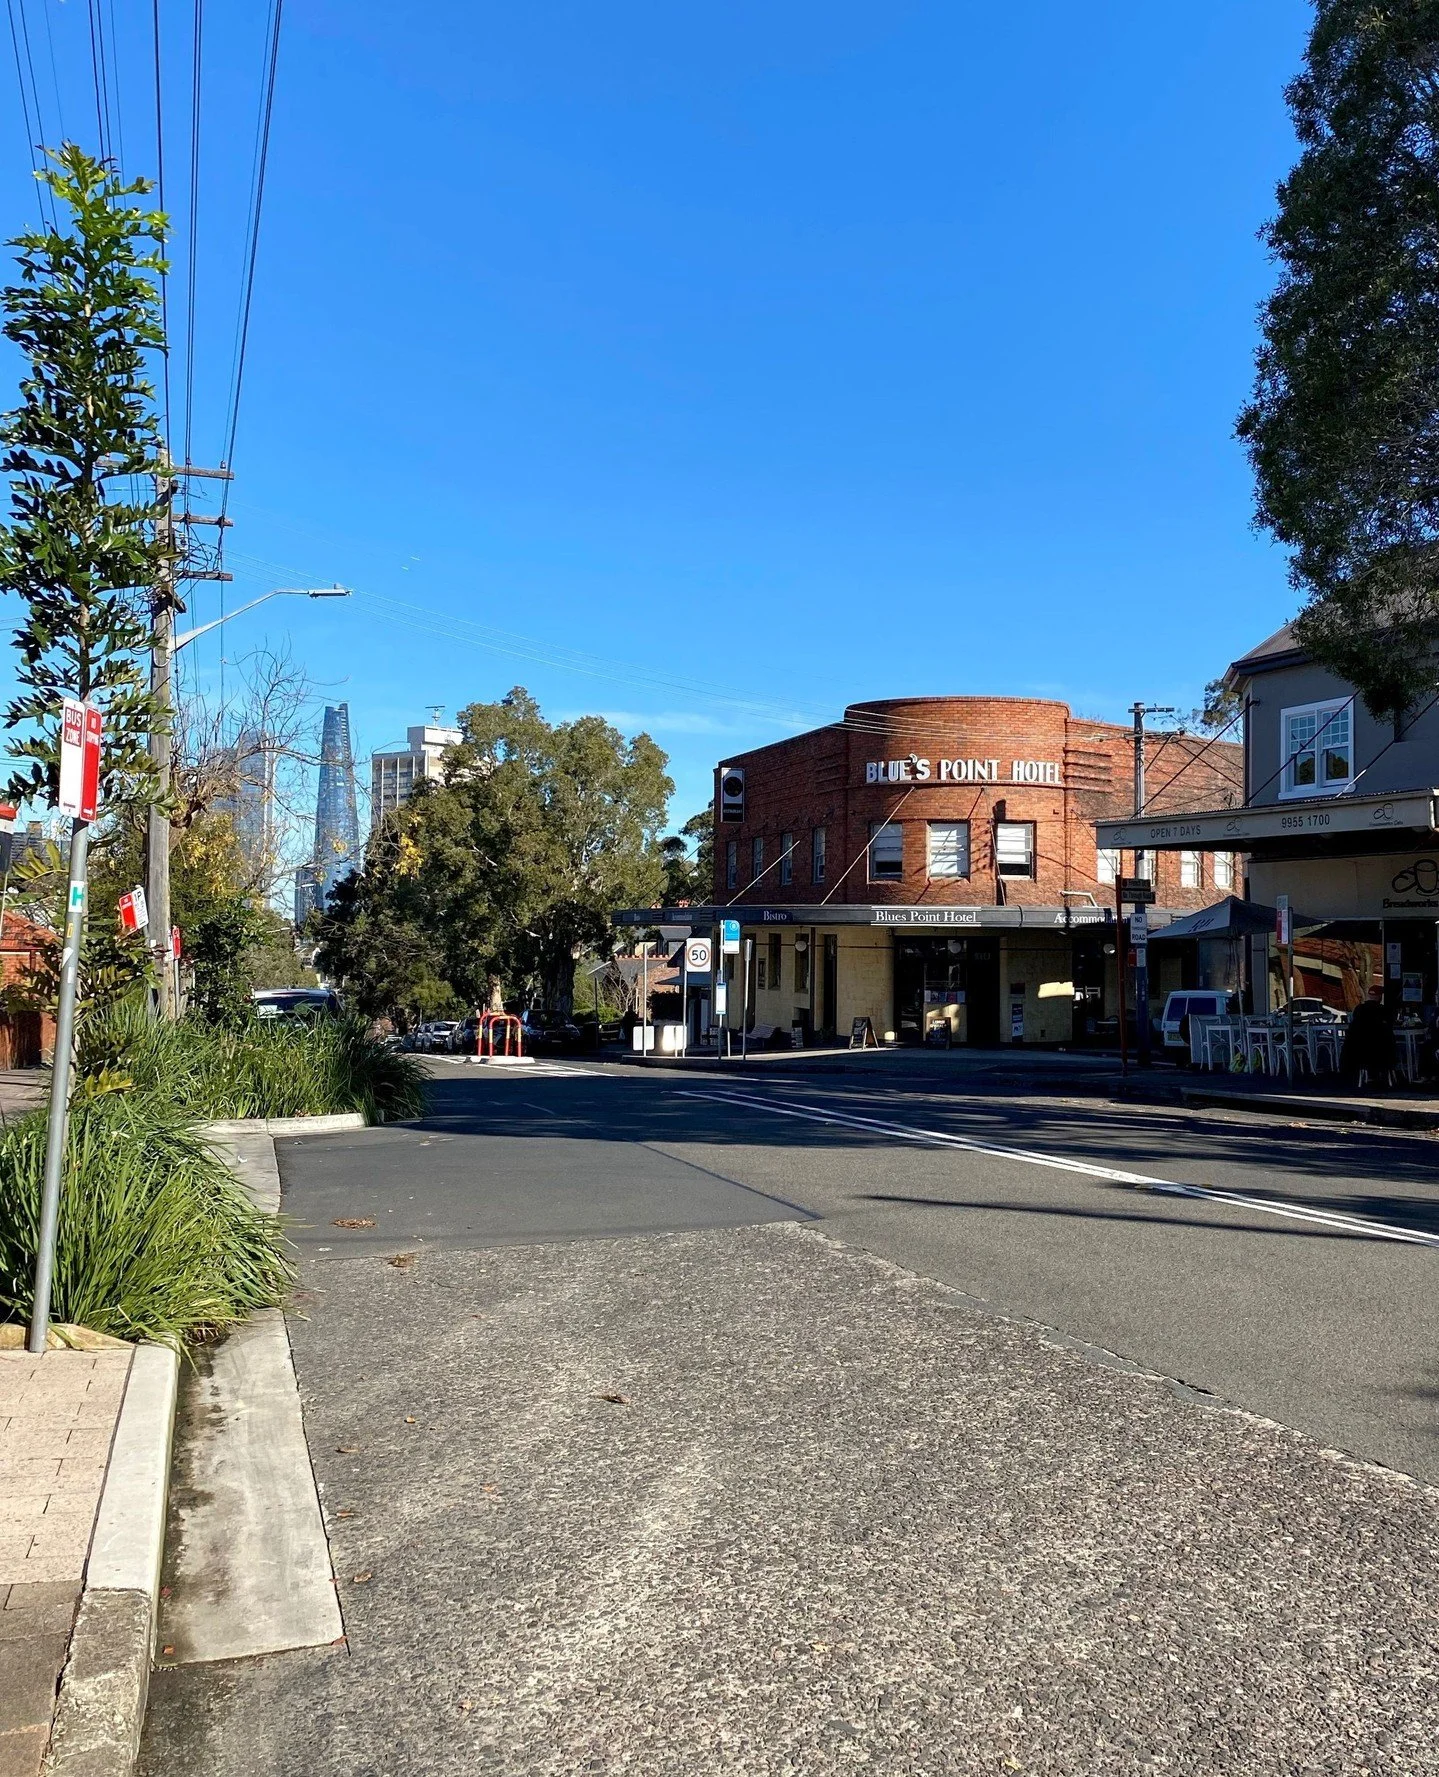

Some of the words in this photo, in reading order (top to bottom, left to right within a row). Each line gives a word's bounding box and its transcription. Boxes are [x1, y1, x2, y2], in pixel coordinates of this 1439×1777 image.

[66, 708, 82, 728] BUS
[65, 727, 80, 745] ZONE
[866, 753, 931, 783] BLUE'S
[939, 759, 1001, 781] POINT
[1012, 760, 1062, 784] HOTEL
[1281, 816, 1304, 829] 9955
[1307, 814, 1330, 827] 1700
[1150, 827, 1171, 839] OPEN
[1173, 826, 1178, 837] 7
[1180, 825, 1201, 837] DAYS
[763, 910, 787, 921] Bistro
[875, 910, 907, 922] Blues
[910, 910, 941, 922] Point
[943, 910, 977, 922] Hotel
[691, 949, 707, 961] 50
